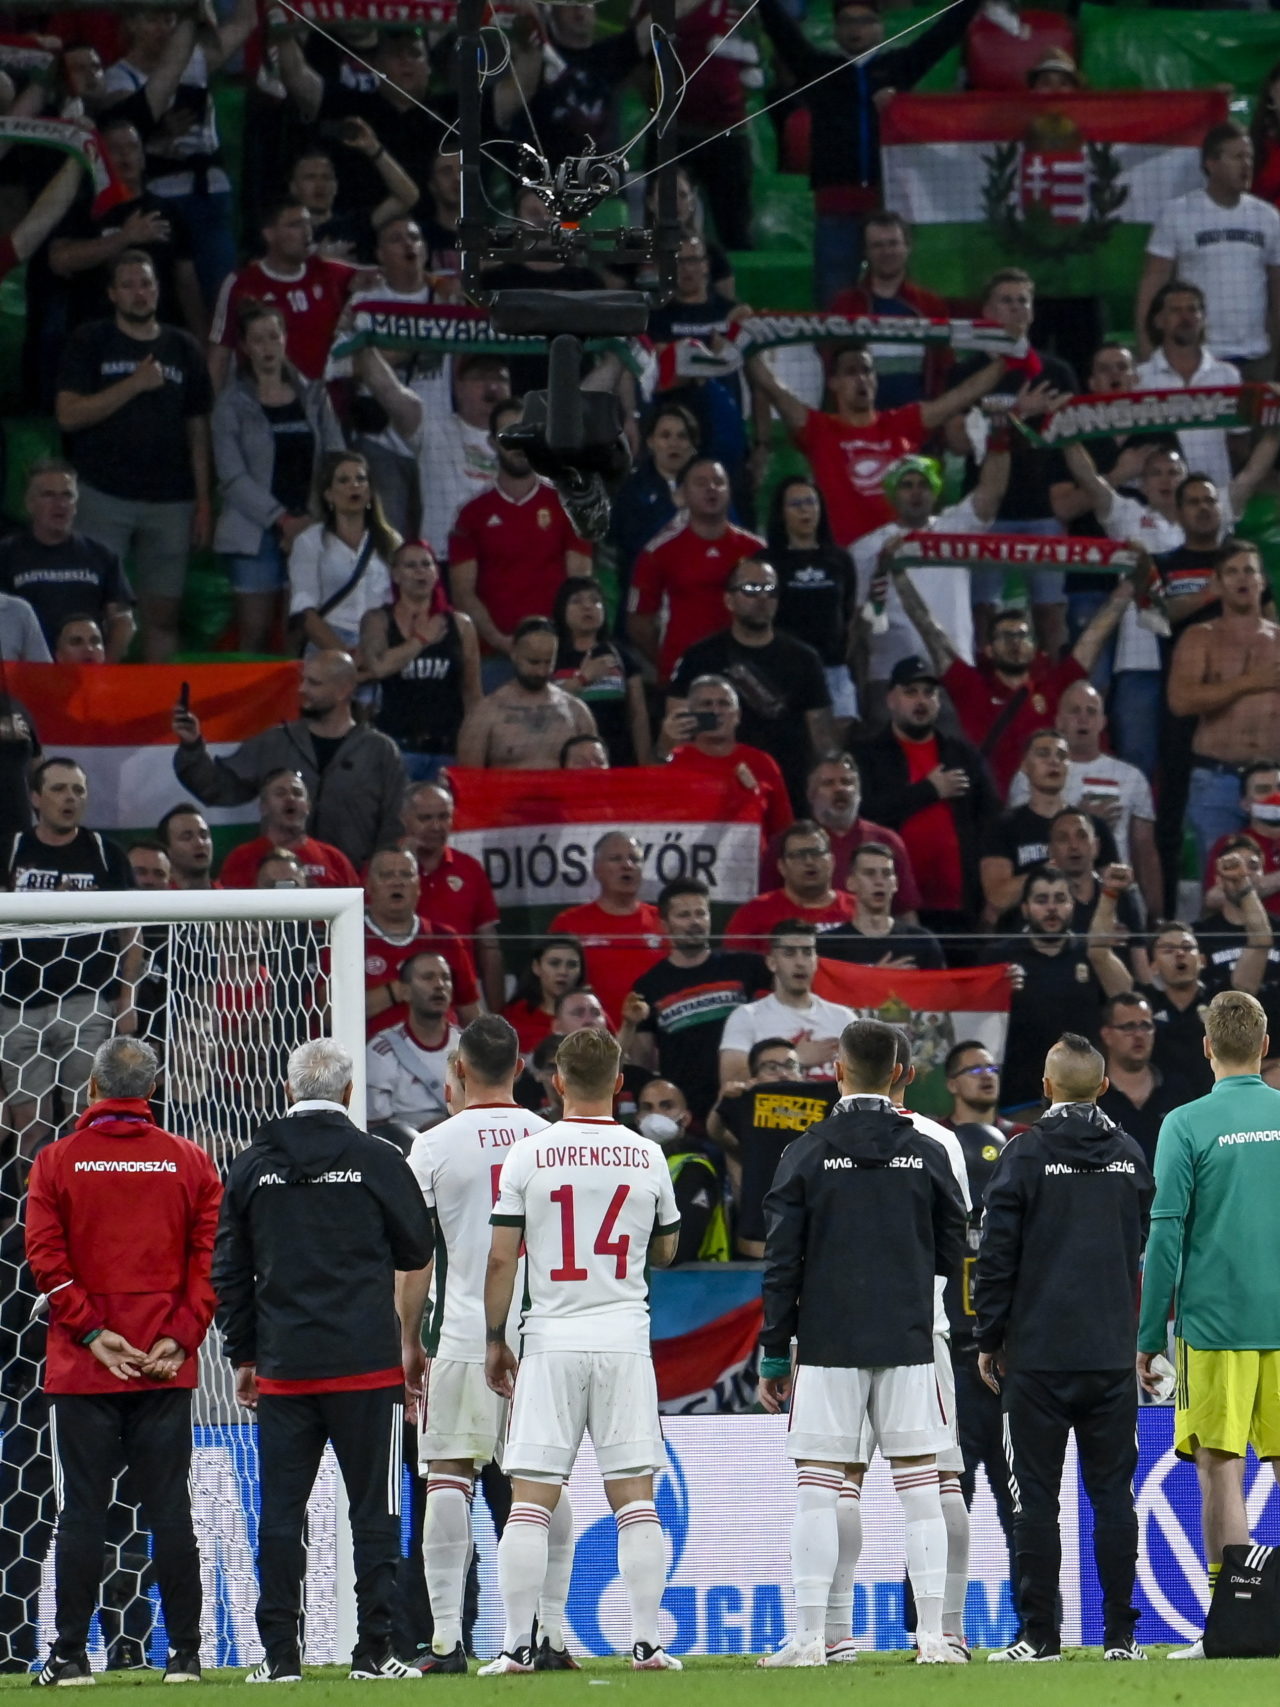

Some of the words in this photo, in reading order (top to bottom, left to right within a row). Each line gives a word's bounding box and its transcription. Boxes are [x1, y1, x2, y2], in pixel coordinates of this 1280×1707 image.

[923, 540, 1117, 567] HUNGARY
[485, 832, 718, 888] DIÓSŐR
[75, 1160, 178, 1173] MAGYARORSZÁG
[535, 1146, 650, 1169] LOVRENCSICS
[823, 1154, 923, 1171] MAGSZÁG
[550, 1184, 631, 1281] 14
